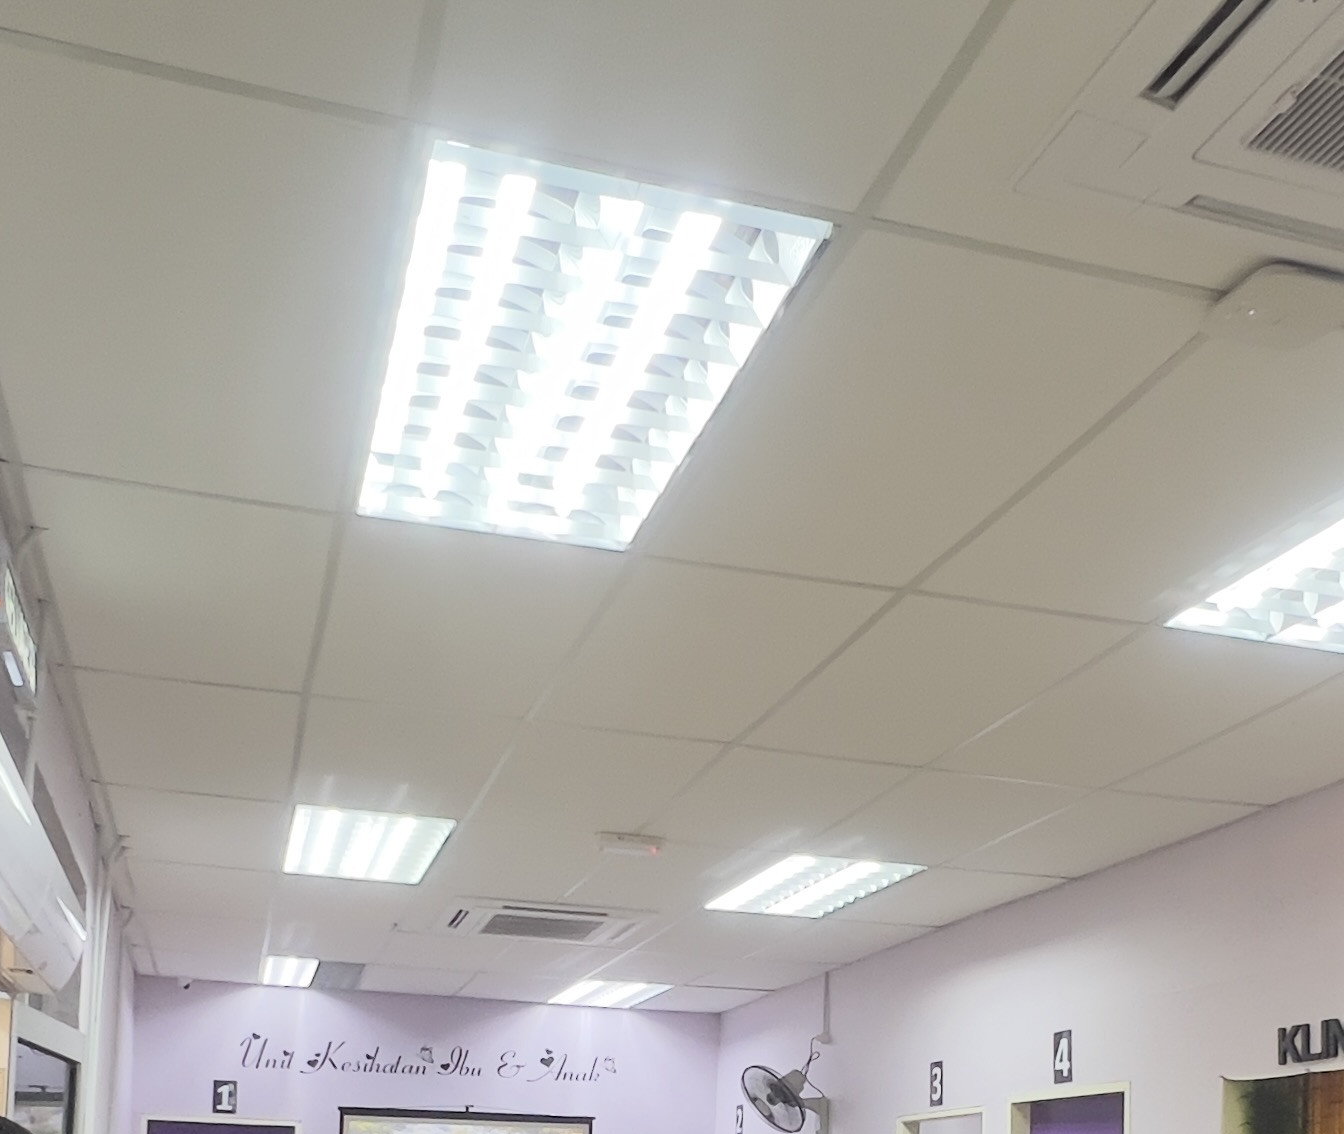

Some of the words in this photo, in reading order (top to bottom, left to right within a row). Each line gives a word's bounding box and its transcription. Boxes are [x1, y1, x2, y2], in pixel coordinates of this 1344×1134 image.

[240, 1033, 295, 1069] Unit
[299, 1041, 427, 1075] Kesihatan
[437, 1045, 482, 1077] Ibu
[497, 1050, 525, 1079] &
[526, 1050, 600, 1082] Anak
[1054, 1037, 1071, 1078] 4
[216, 1085, 233, 1110] 1
[931, 1066, 942, 1101] 3
